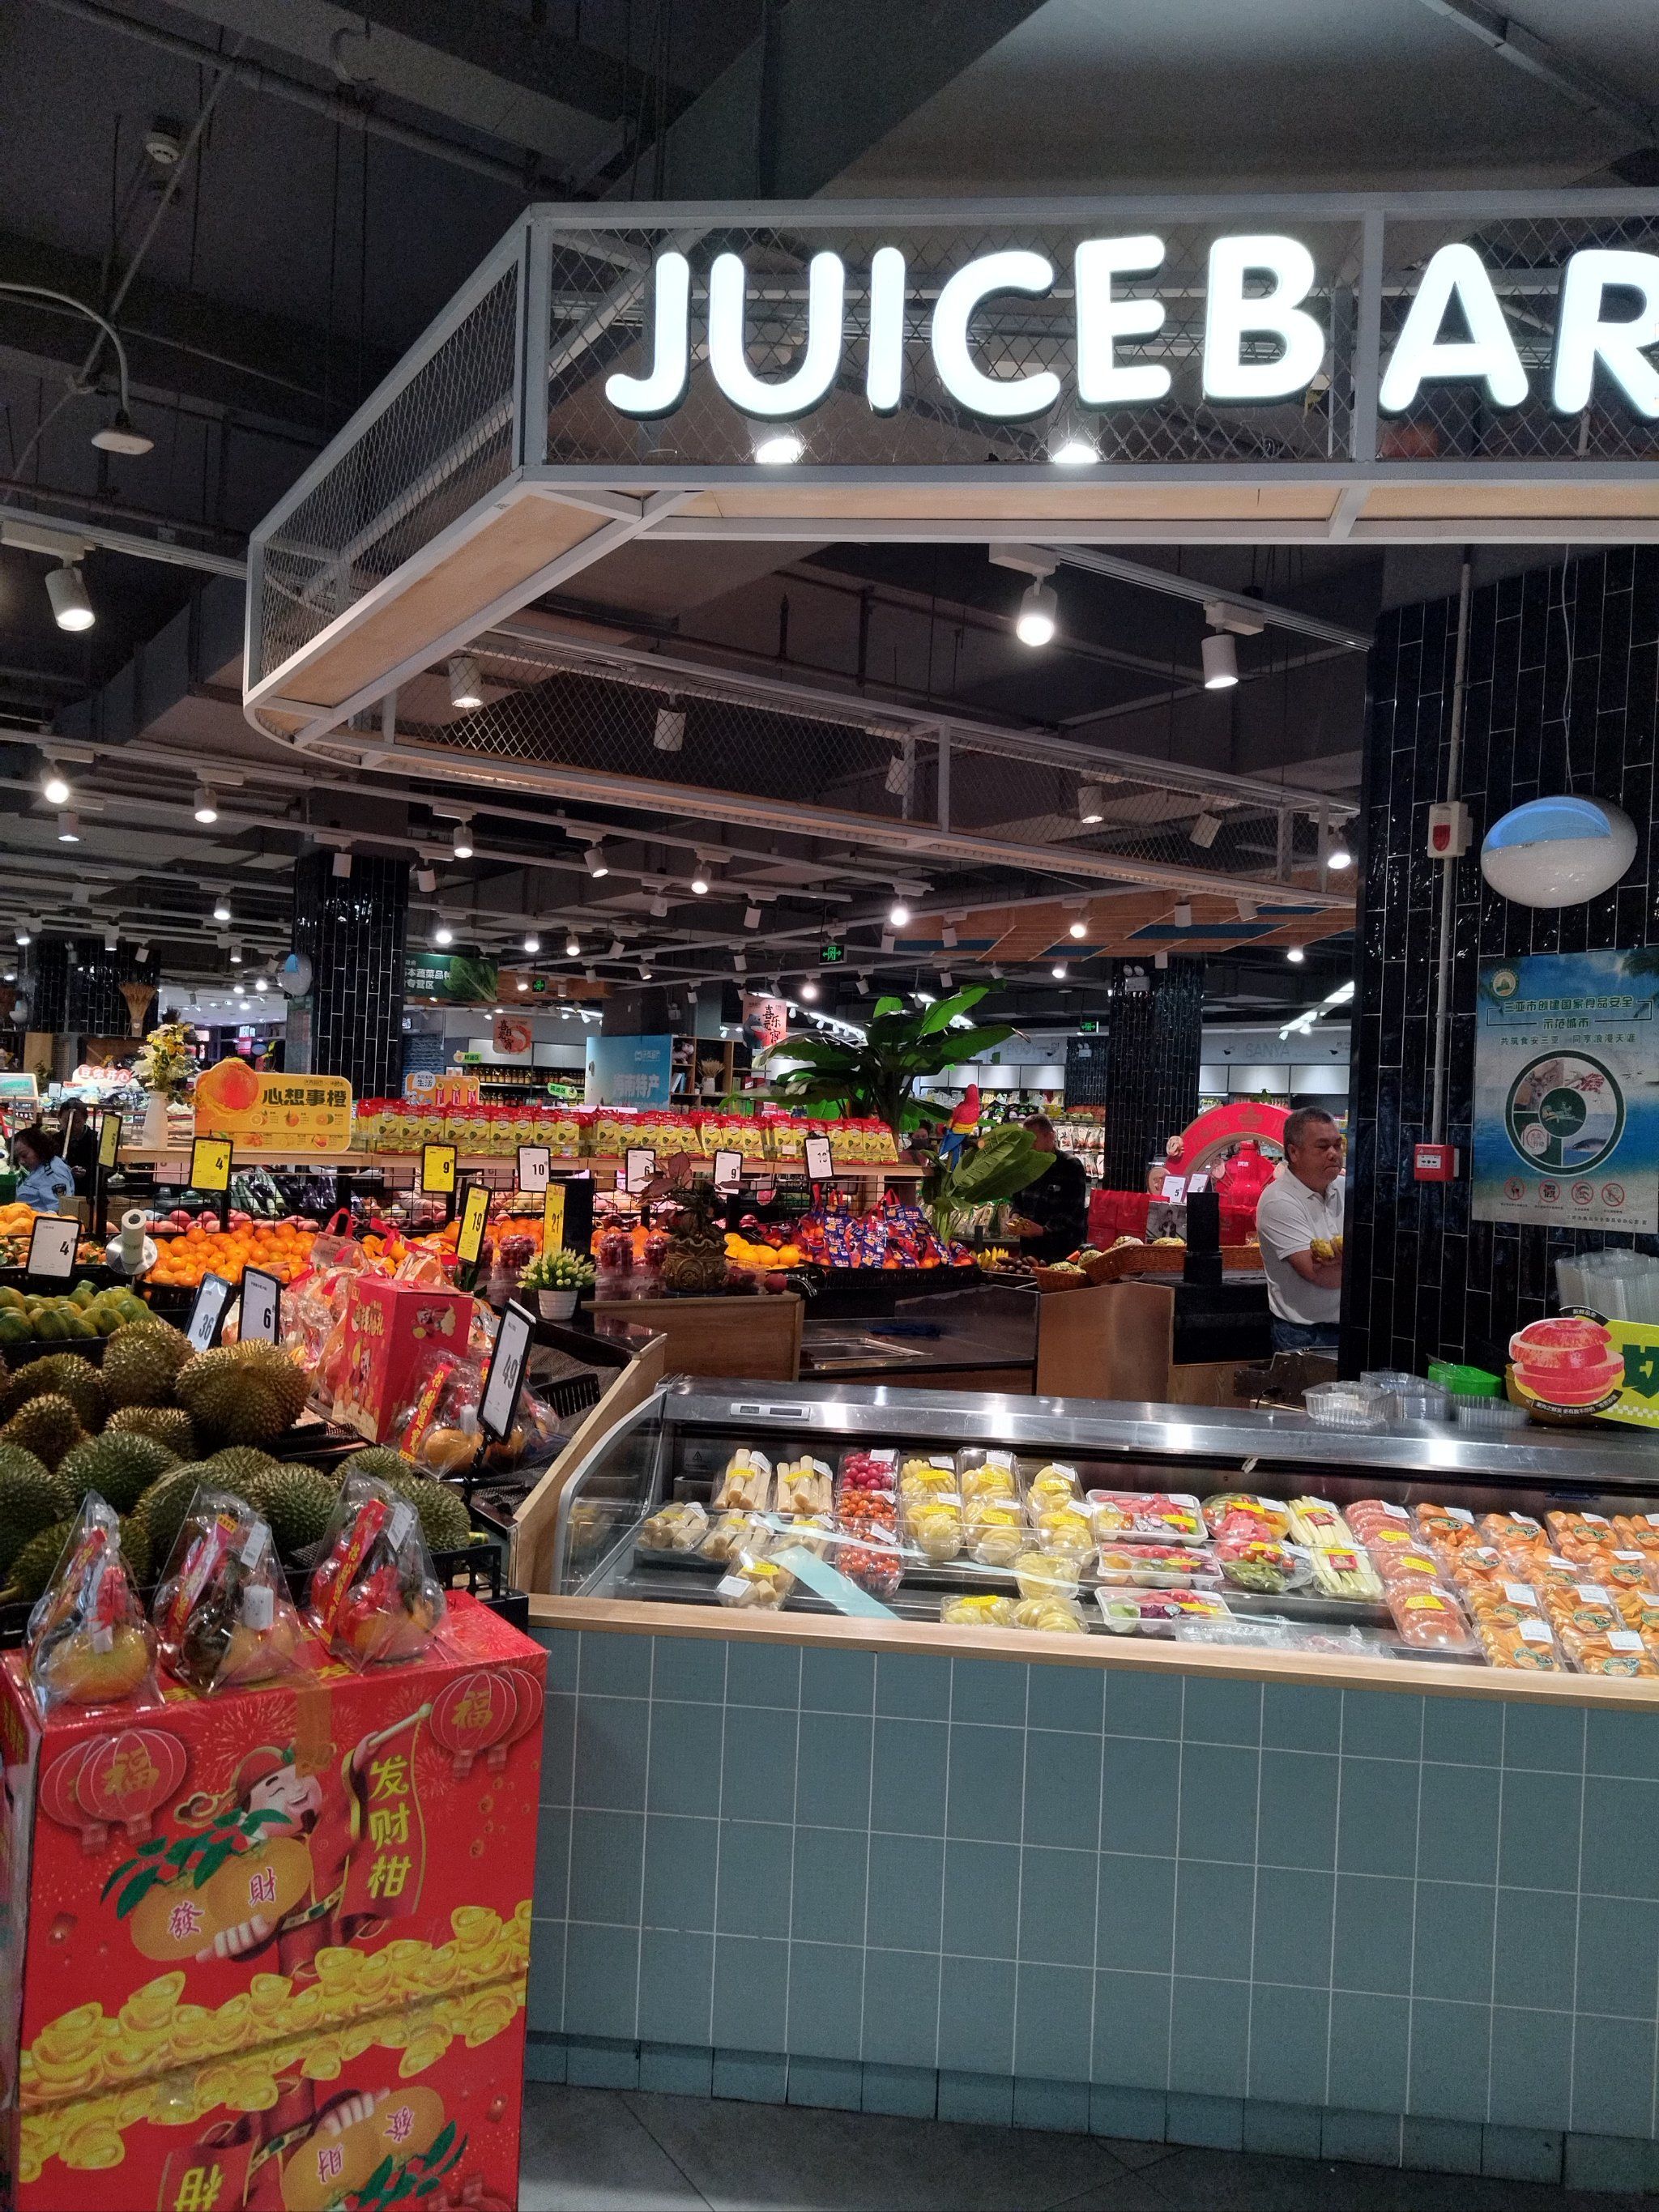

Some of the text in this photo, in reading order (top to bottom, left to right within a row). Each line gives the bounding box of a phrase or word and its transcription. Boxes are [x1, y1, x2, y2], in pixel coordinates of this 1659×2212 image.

[404, 978, 435, 990] 专营区
[1503, 996, 1633, 1012] 三亚市创建国家食品安全
[1543, 1017, 1589, 1029] 示范城市
[1500, 1033, 1636, 1046] 共筑食安三亚 同享浪漫天涯
[262, 1088, 347, 1107] 心想事橙
[215, 1157, 224, 1170] 4
[443, 1161, 450, 1174] 9
[531, 1163, 545, 1175] 10
[731, 1168, 736, 1179] 9
[471, 1211, 483, 1232] 19
[59, 1241, 70, 1255] 4
[263, 1307, 272, 1329] 6
[198, 1314, 215, 1340] 36
[502, 1354, 518, 1390] 49
[451, 1690, 493, 1730] 福
[103, 1746, 160, 1796] 福
[369, 1754, 411, 1900] 发财柑
